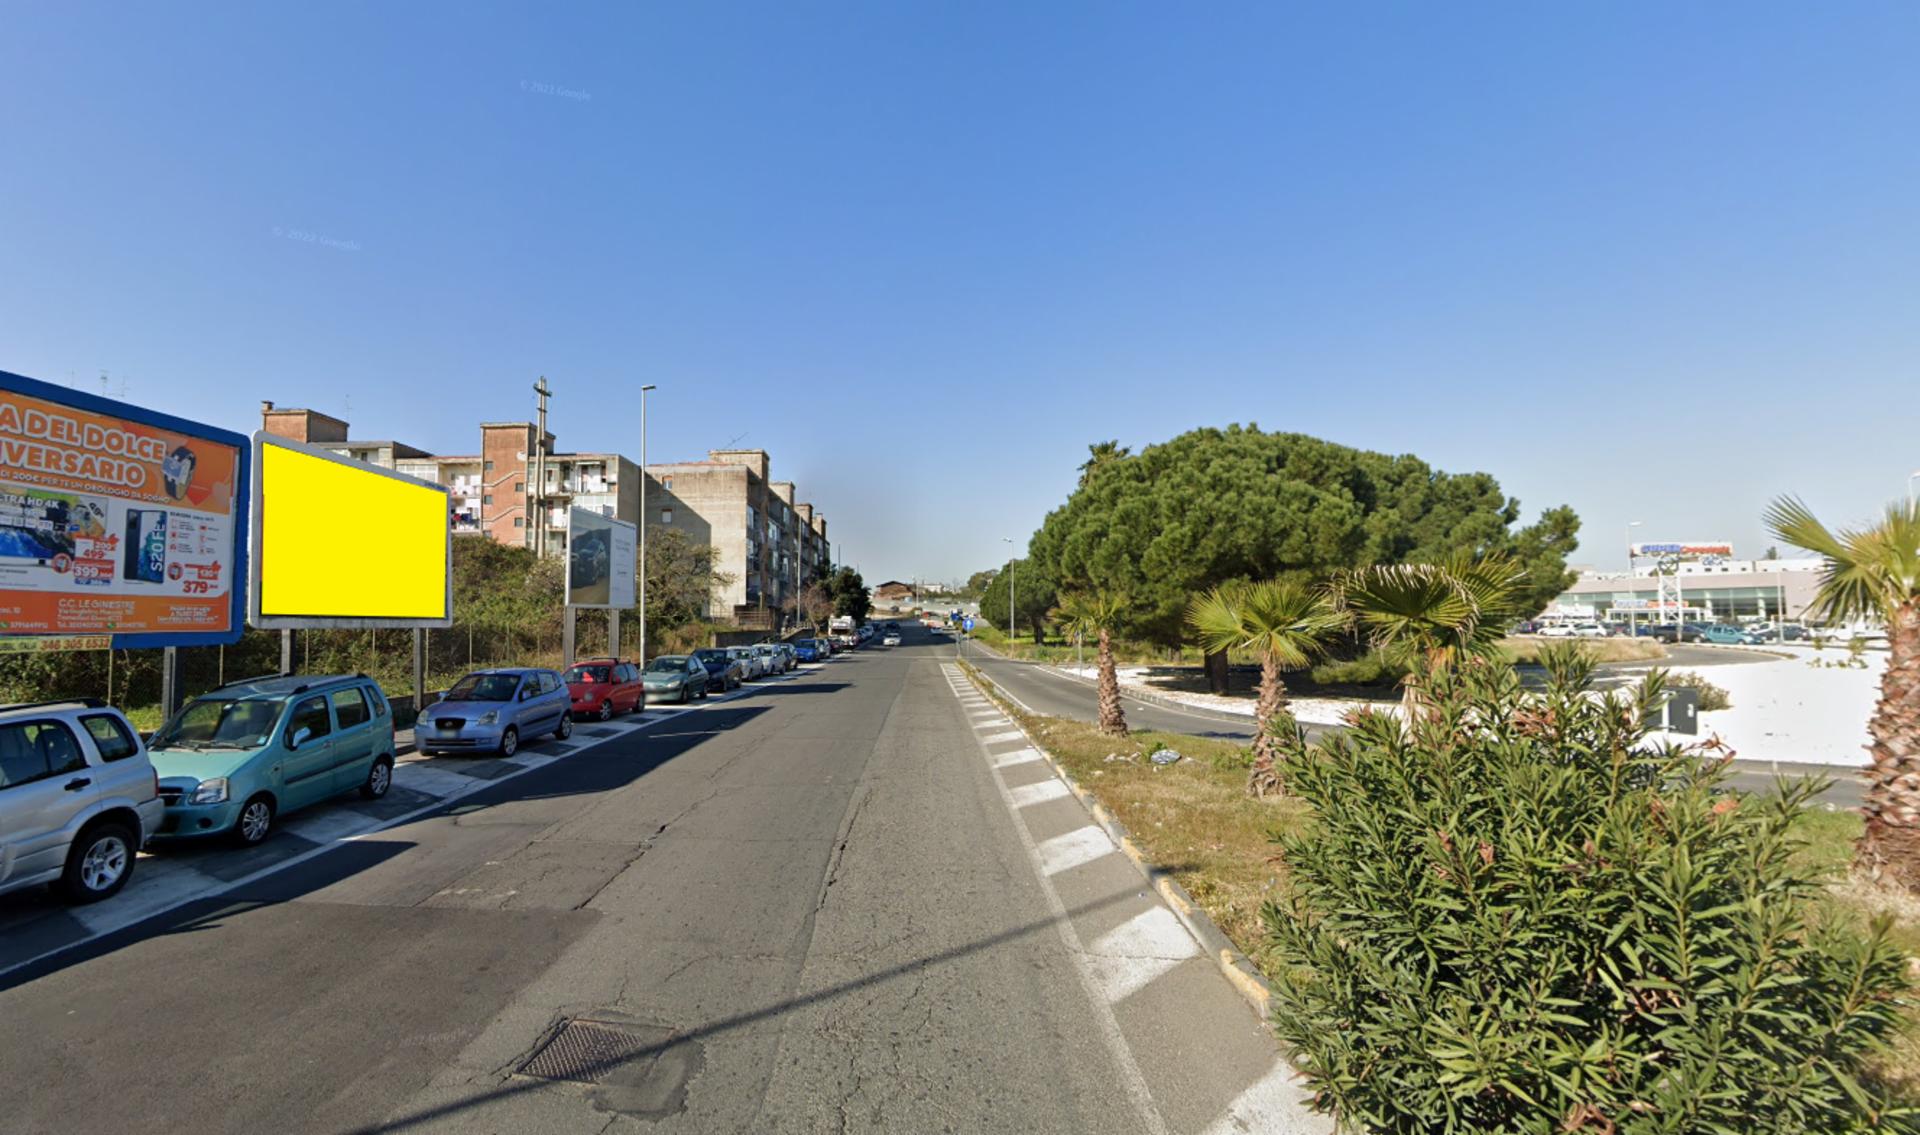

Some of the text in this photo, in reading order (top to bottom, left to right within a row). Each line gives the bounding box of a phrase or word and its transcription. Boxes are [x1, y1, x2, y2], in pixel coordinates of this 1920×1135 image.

[24, 409, 81, 446] DEL
[83, 423, 166, 464] DOLCE
[27, 496, 43, 507] HD
[45, 499, 59, 509] 4K
[151, 543, 164, 572] S20
[182, 581, 208, 593] 379
